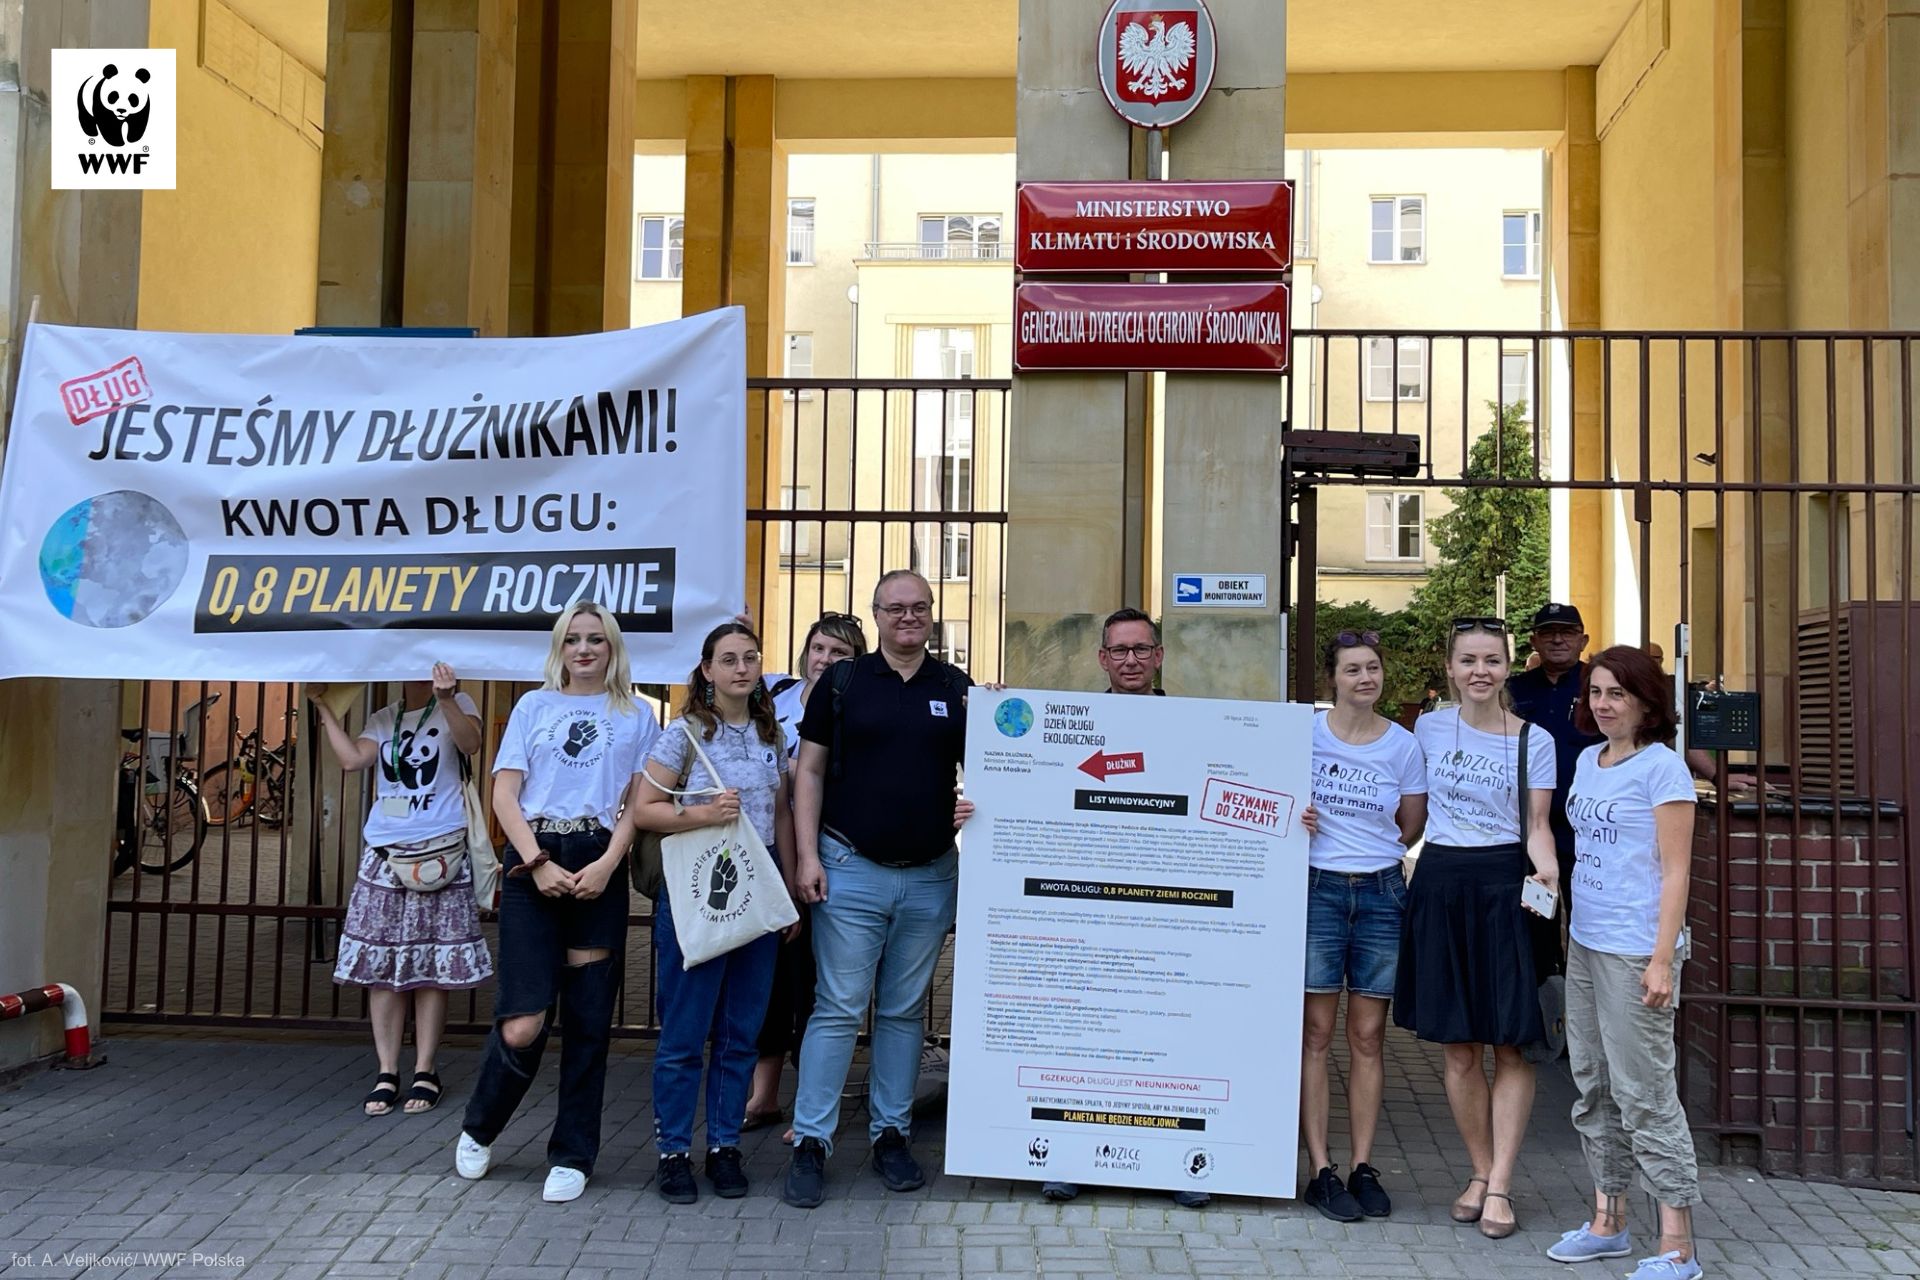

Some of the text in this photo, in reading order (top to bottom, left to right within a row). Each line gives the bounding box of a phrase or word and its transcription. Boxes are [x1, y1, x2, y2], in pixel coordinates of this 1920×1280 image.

[1075, 200, 1230, 217] MINISTERSTWO
[1030, 228, 1276, 250] KLIMATU i ŚRODOWISKA
[1021, 304, 1282, 345] GENERALNA DYREKCJA OCHRONY ŚRODOWISKA
[69, 370, 141, 414] DŁUG
[88, 388, 677, 467] JESTEŚMY DŁUŻNIKAMI!
[221, 493, 617, 537] KWOTA DŁUGU:
[208, 562, 660, 625] 0,8 PLANETY ROCZNIE
[1218, 581, 1249, 590] OBIEKT
[1204, 592, 1263, 601] MONITOROWANY
[1045, 702, 1090, 716] ŚWIATOWY
[1044, 717, 1094, 731] DZIEŃ DŁUGU
[1043, 732, 1106, 746] EKOLOGICZNEGO
[1106, 758, 1136, 771] DŁUŻNIK
[1089, 795, 1176, 809] LIST WINDYKACYJNY
[1222, 790, 1279, 814] WEZWANIE
[1347, 799, 1384, 812] mama
[1215, 803, 1280, 828] DO ZAPŁATY
[1329, 808, 1356, 818] Leona
[733, 842, 756, 882] STRAJK
[1040, 882, 1219, 902] KWOTA DŁUGU: 0,8 PLANETY ZIEMI ROCZNIE
[699, 890, 753, 923] KLIMATYCZNY
[1040, 1073, 1201, 1091] EGZEKUCJA DŁUGU JEST NIEUNIKNIONA!
[1064, 1111, 1180, 1129] PLANETA NIE BĘDZIE NEGOCJOWAĆ
